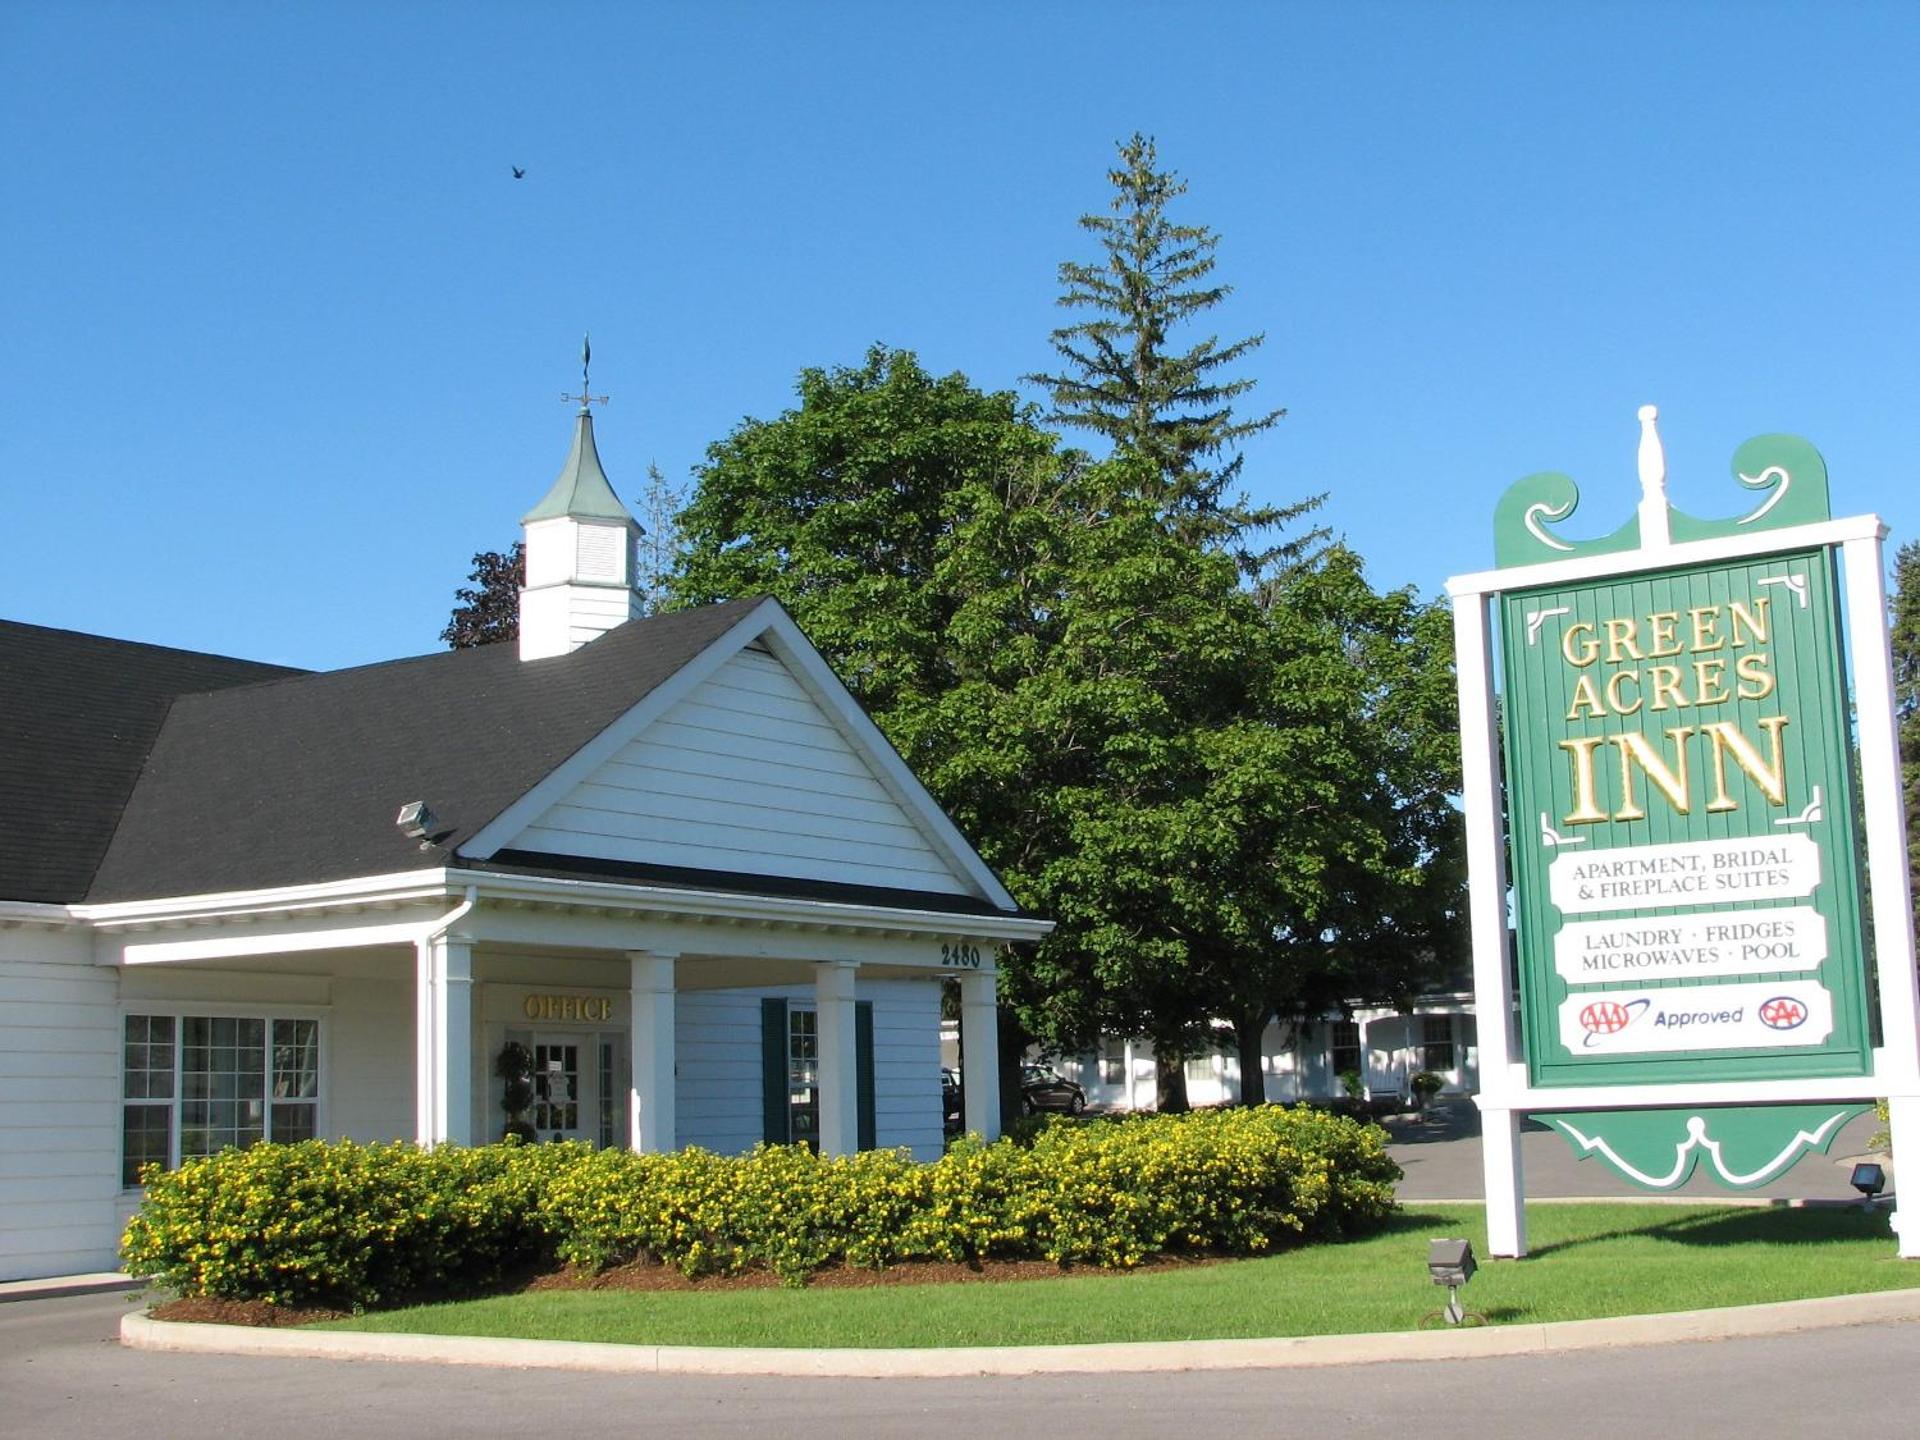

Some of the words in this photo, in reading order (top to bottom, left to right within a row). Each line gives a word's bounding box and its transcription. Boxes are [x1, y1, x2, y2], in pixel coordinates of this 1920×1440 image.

[1562, 597, 1769, 668] GREEN
[1566, 652, 1775, 721] ACRES
[1559, 715, 1789, 826] INN
[1573, 855, 1706, 880] APARTMENT,
[1713, 848, 1793, 870] BRIDAL
[1578, 884, 1595, 900] &
[1601, 876, 1708, 899] FIREPLACE
[1716, 869, 1790, 889] SUITES
[1585, 928, 1682, 950] LAUNDRY
[1706, 921, 1795, 942] FRIDGES
[941, 943, 980, 969] 2480
[1582, 948, 1720, 972] MICROWAVES
[1742, 942, 1800, 961] POOL
[525, 994, 612, 1022] OFFICE
[1581, 1004, 1629, 1032] AAA
[1654, 1007, 1743, 1029] Approved
[1762, 1001, 1801, 1027] CAA
